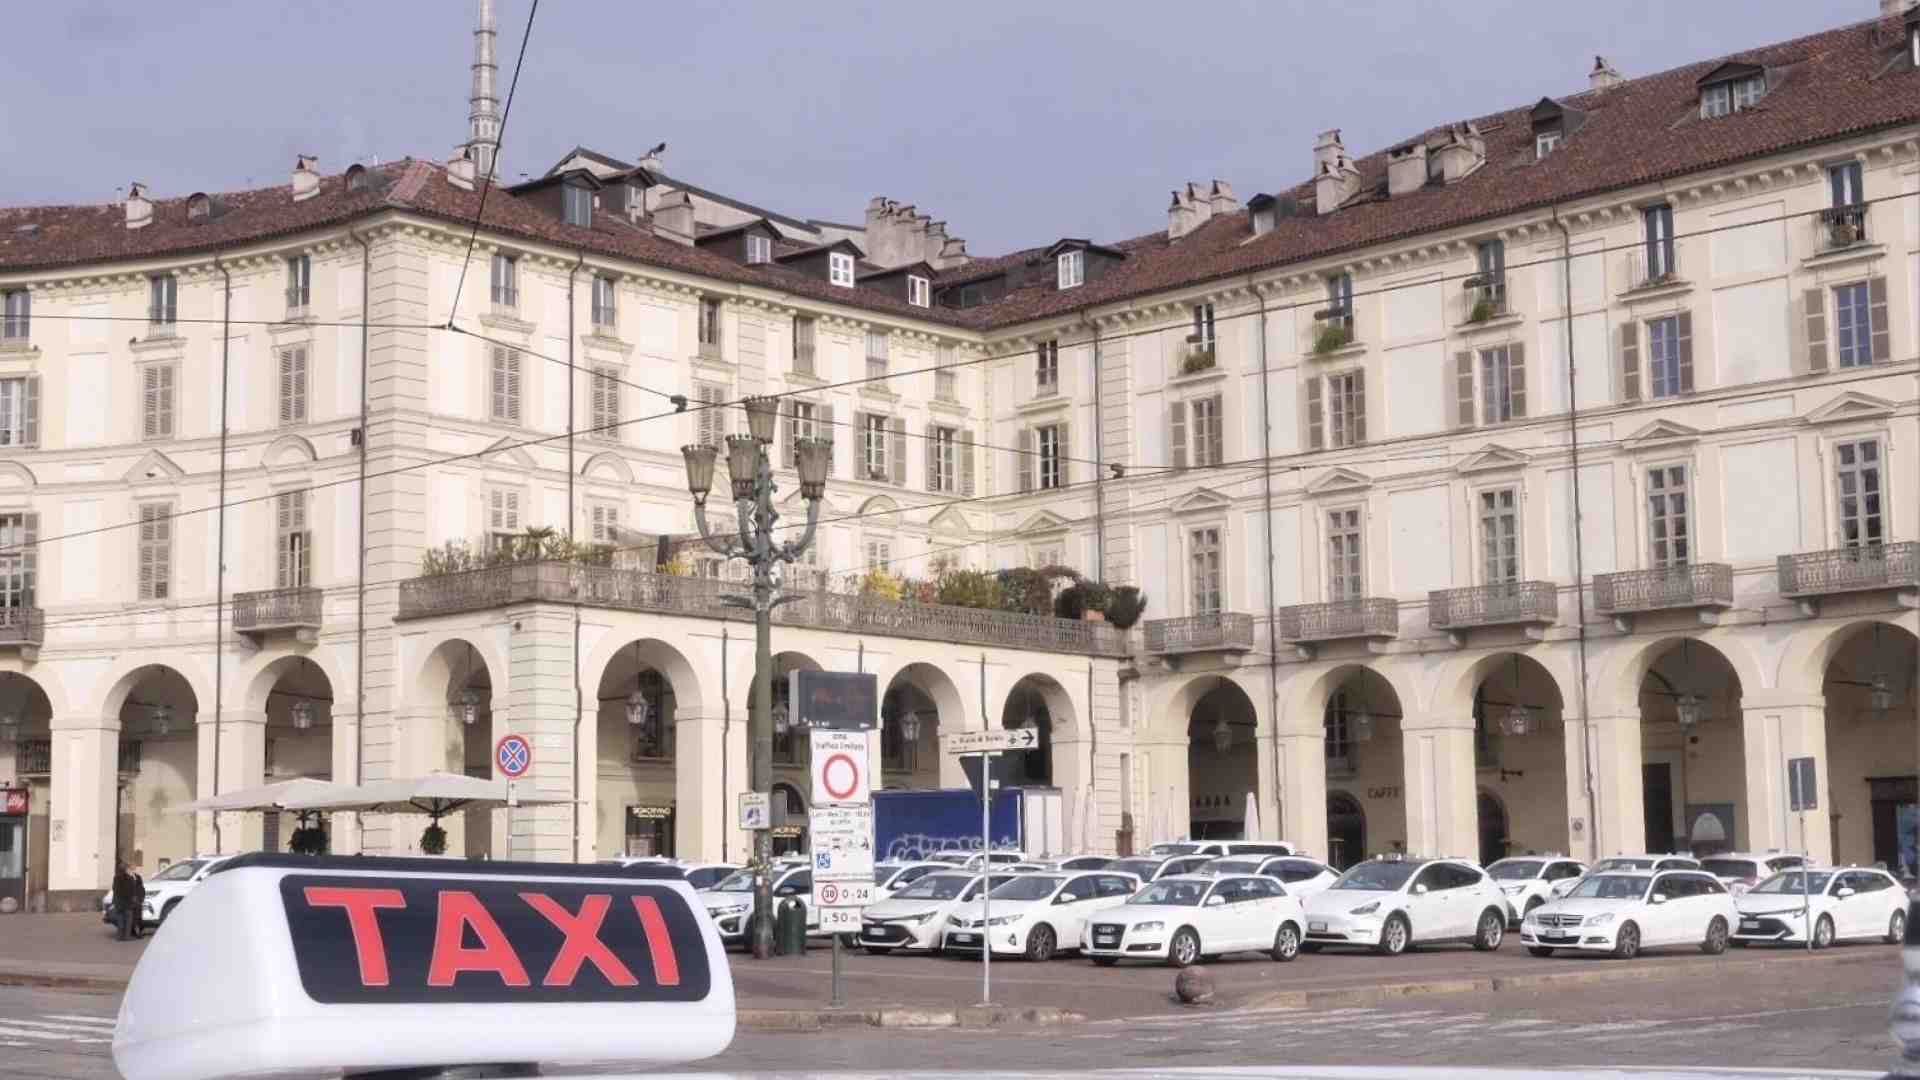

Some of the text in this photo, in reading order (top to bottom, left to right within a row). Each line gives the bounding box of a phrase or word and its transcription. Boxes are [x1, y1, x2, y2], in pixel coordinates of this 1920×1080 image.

[842, 889, 849, 899] 0
[857, 889, 868, 899] 24
[303, 886, 680, 987] TAXI
